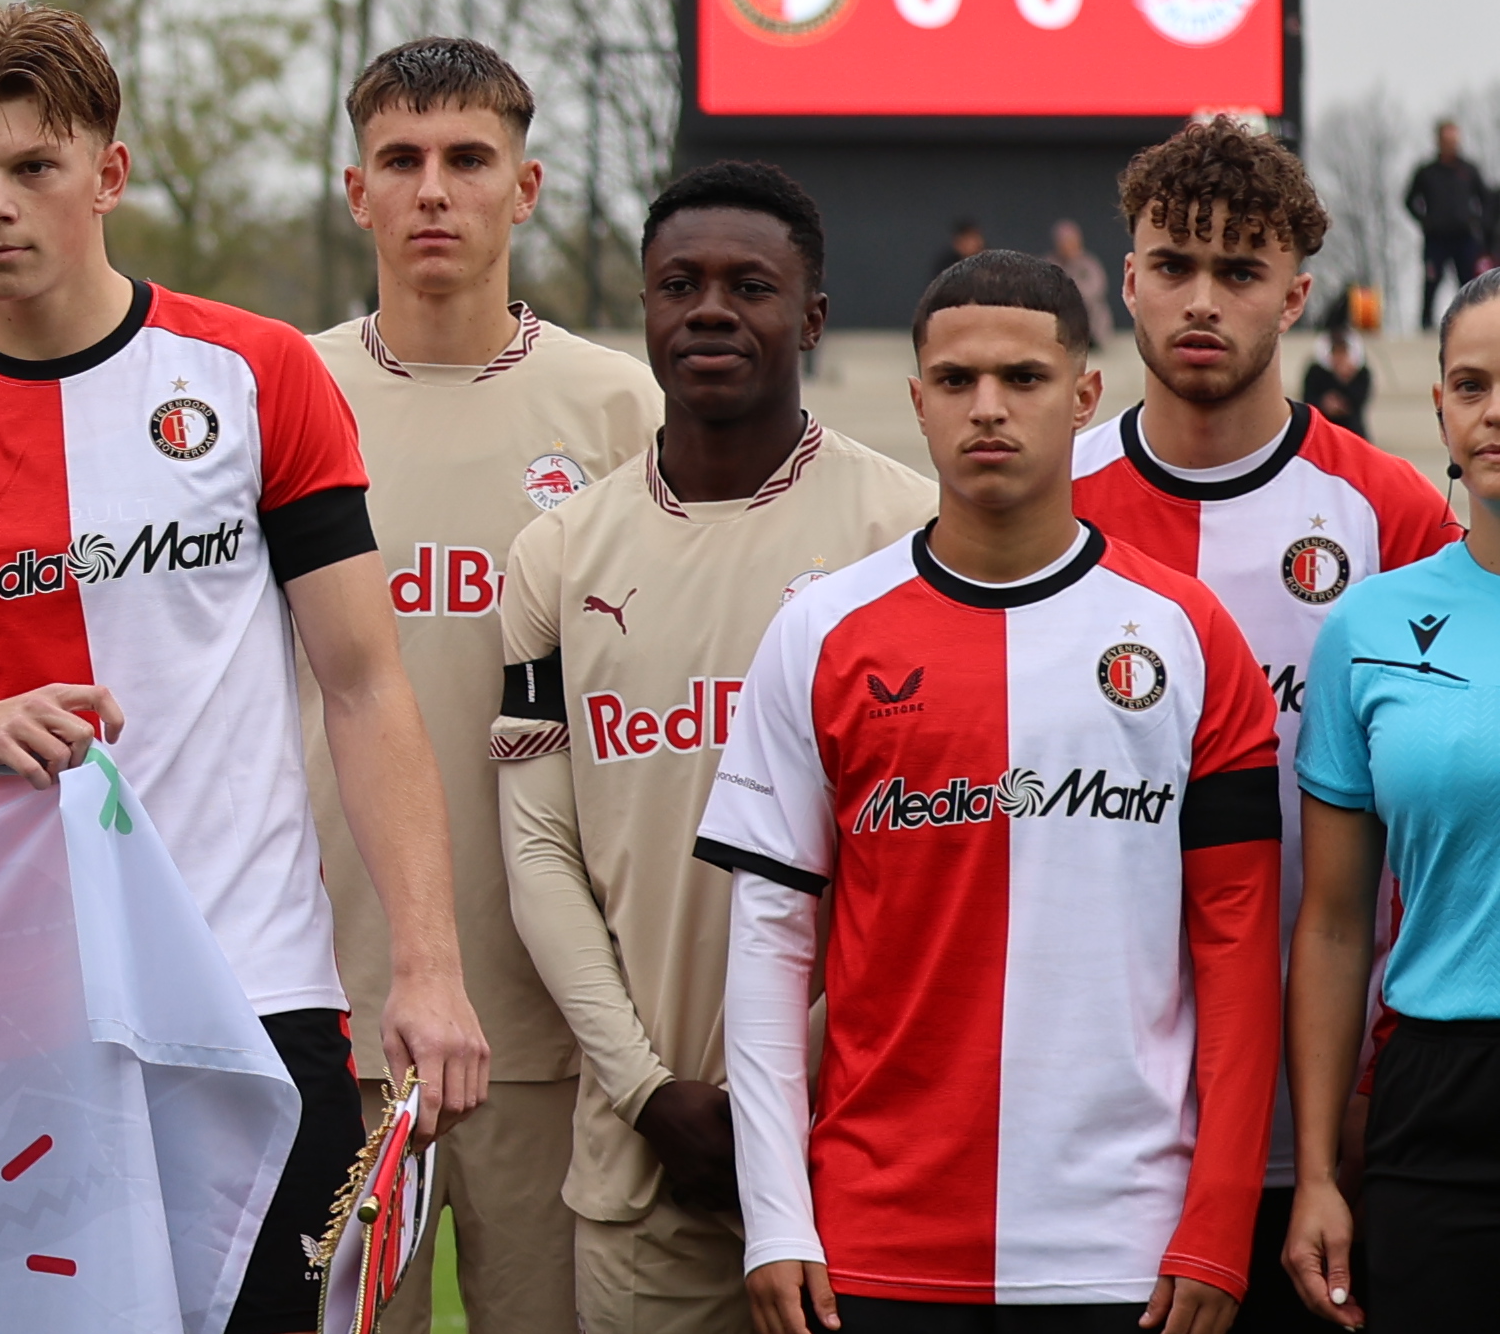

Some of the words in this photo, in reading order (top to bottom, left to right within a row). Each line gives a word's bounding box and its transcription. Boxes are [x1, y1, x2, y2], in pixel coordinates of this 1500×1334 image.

[152, 399, 213, 424] FEYENOORD
[156, 431, 216, 459] ROTTERDAM
[550, 458, 563, 468] FC
[112, 519, 244, 578] Markt
[1287, 538, 1346, 562] FEYENOORD
[1286, 574, 1346, 602] ROTTERDAM
[1102, 644, 1161, 669] FEYENOORD
[1102, 681, 1162, 709] ROTTERDAM
[869, 702, 925, 719] CASTORE
[852, 777, 996, 833] Media
[1041, 768, 1176, 824] Markt
